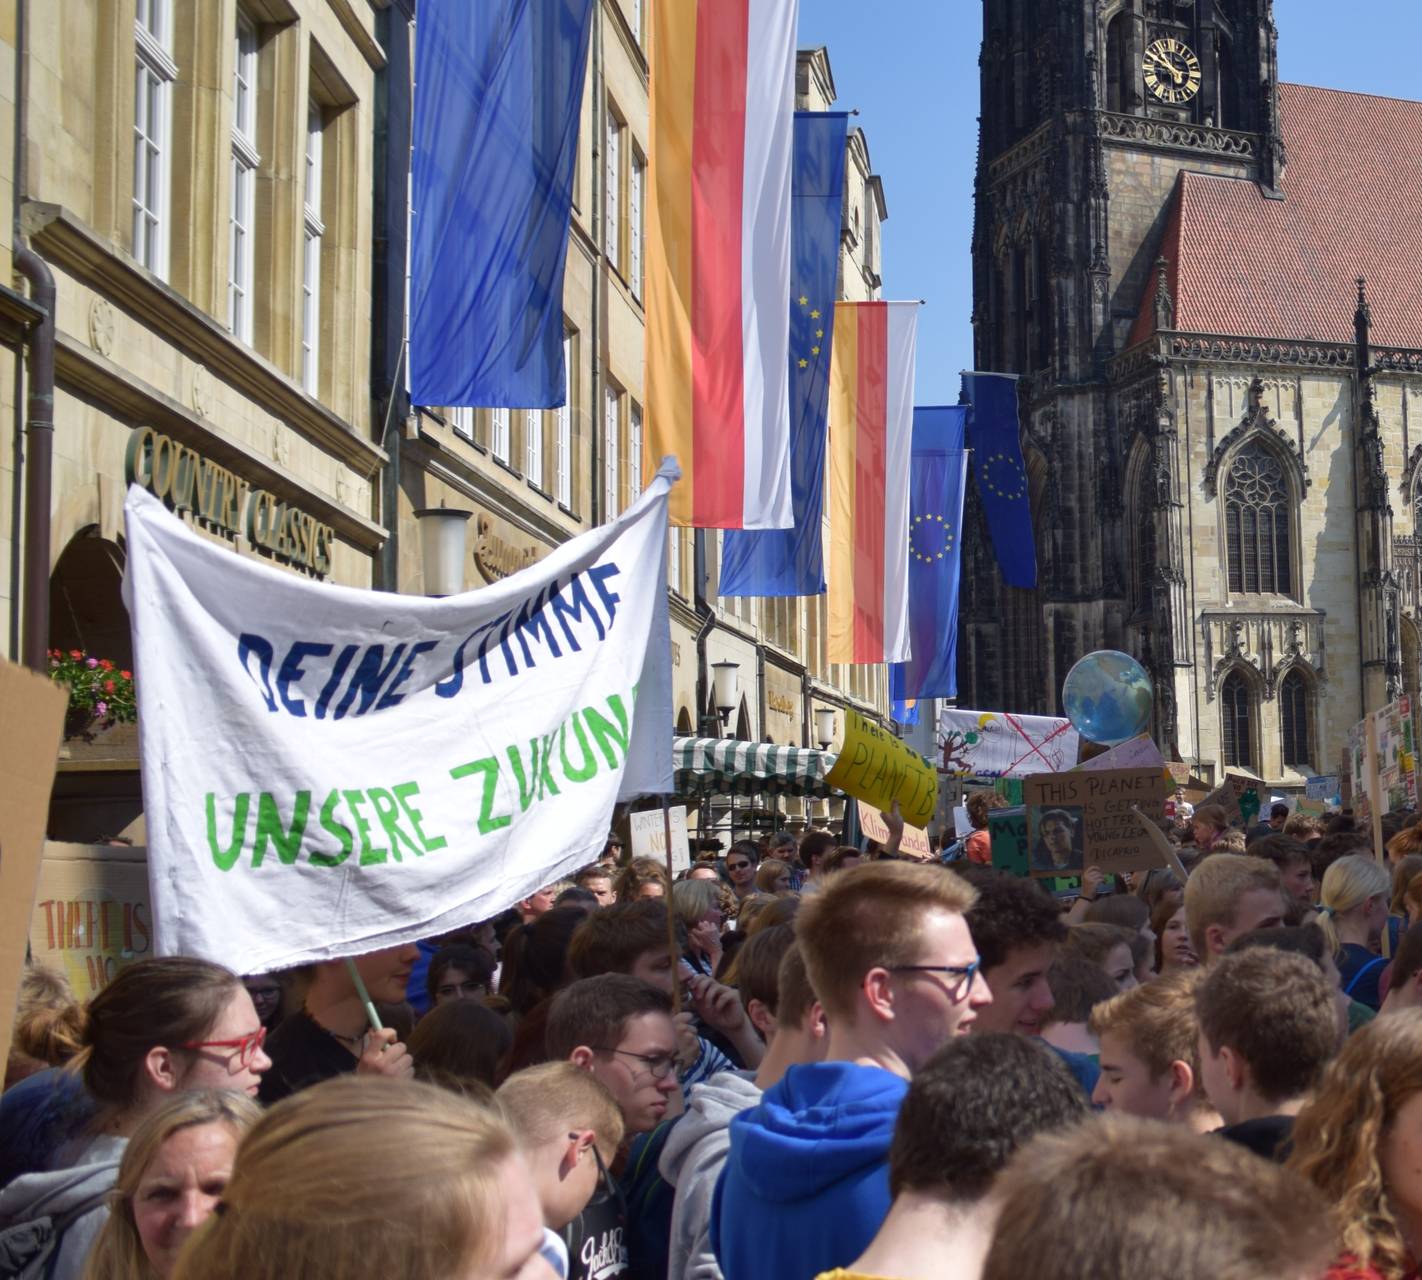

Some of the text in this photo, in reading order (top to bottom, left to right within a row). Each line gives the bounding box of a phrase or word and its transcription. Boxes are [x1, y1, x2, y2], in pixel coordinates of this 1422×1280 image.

[125, 426, 334, 576] COUNTRY CLASSICS
[238, 632, 440, 720] DEINE
[205, 684, 638, 872] UNSERE ZUKUN
[1036, 775, 1160, 803] THIS PLANET
[1084, 800, 1096, 814] IS
[122, 902, 150, 953] IS
